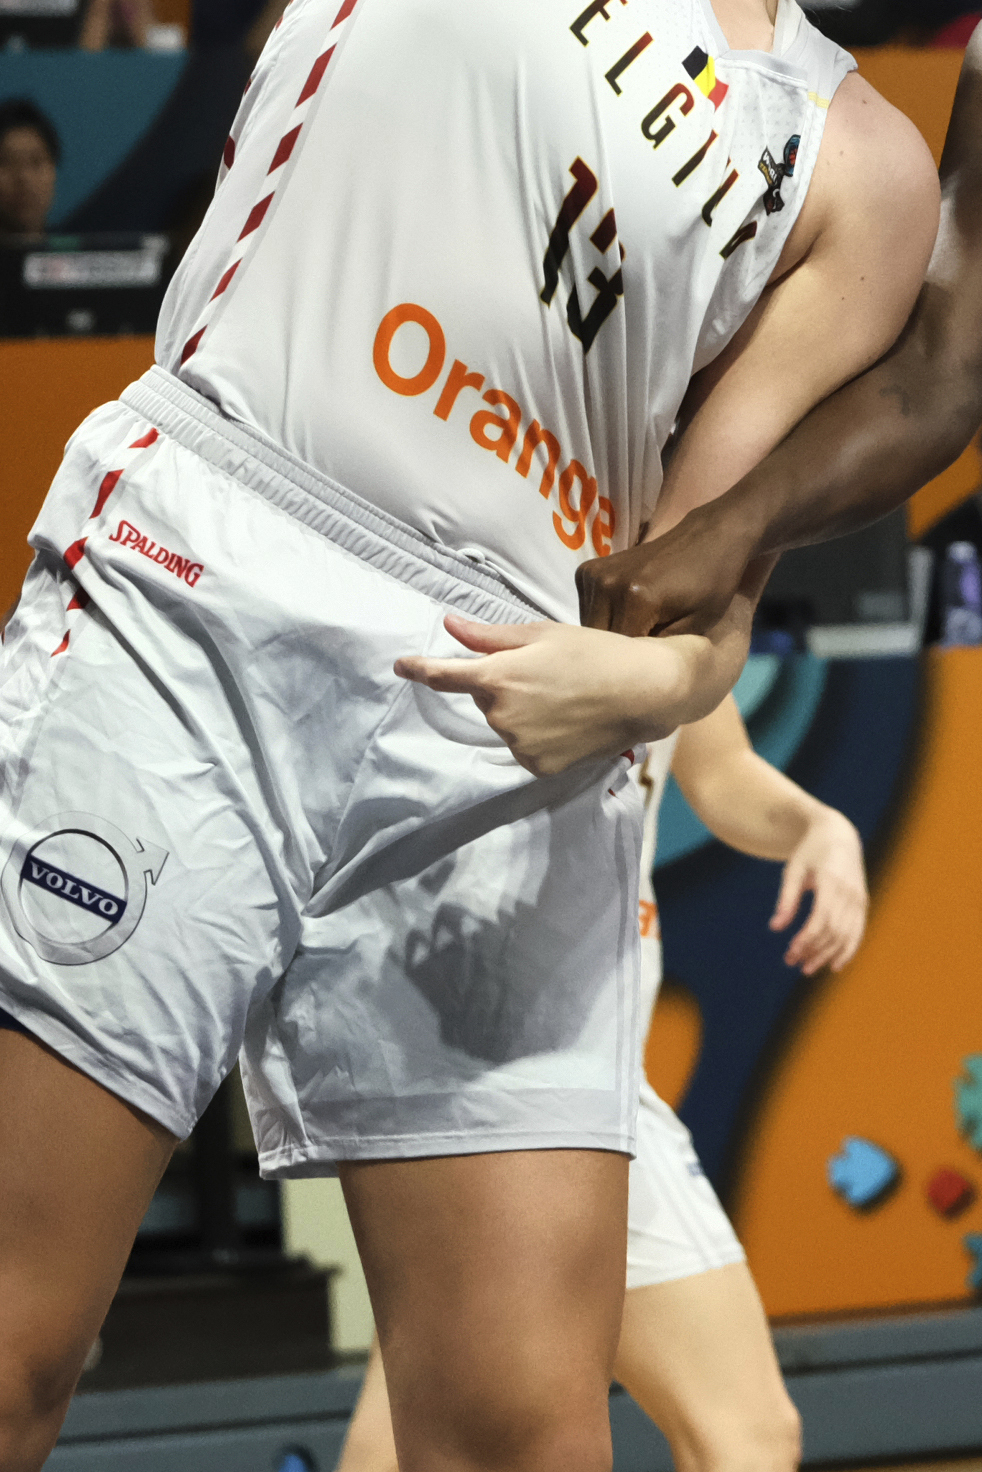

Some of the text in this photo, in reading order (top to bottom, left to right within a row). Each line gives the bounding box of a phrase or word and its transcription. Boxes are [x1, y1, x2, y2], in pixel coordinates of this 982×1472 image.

[372, 302, 615, 558] Orange
[109, 520, 204, 588] SPALDING
[28, 859, 120, 918] VOLVO
